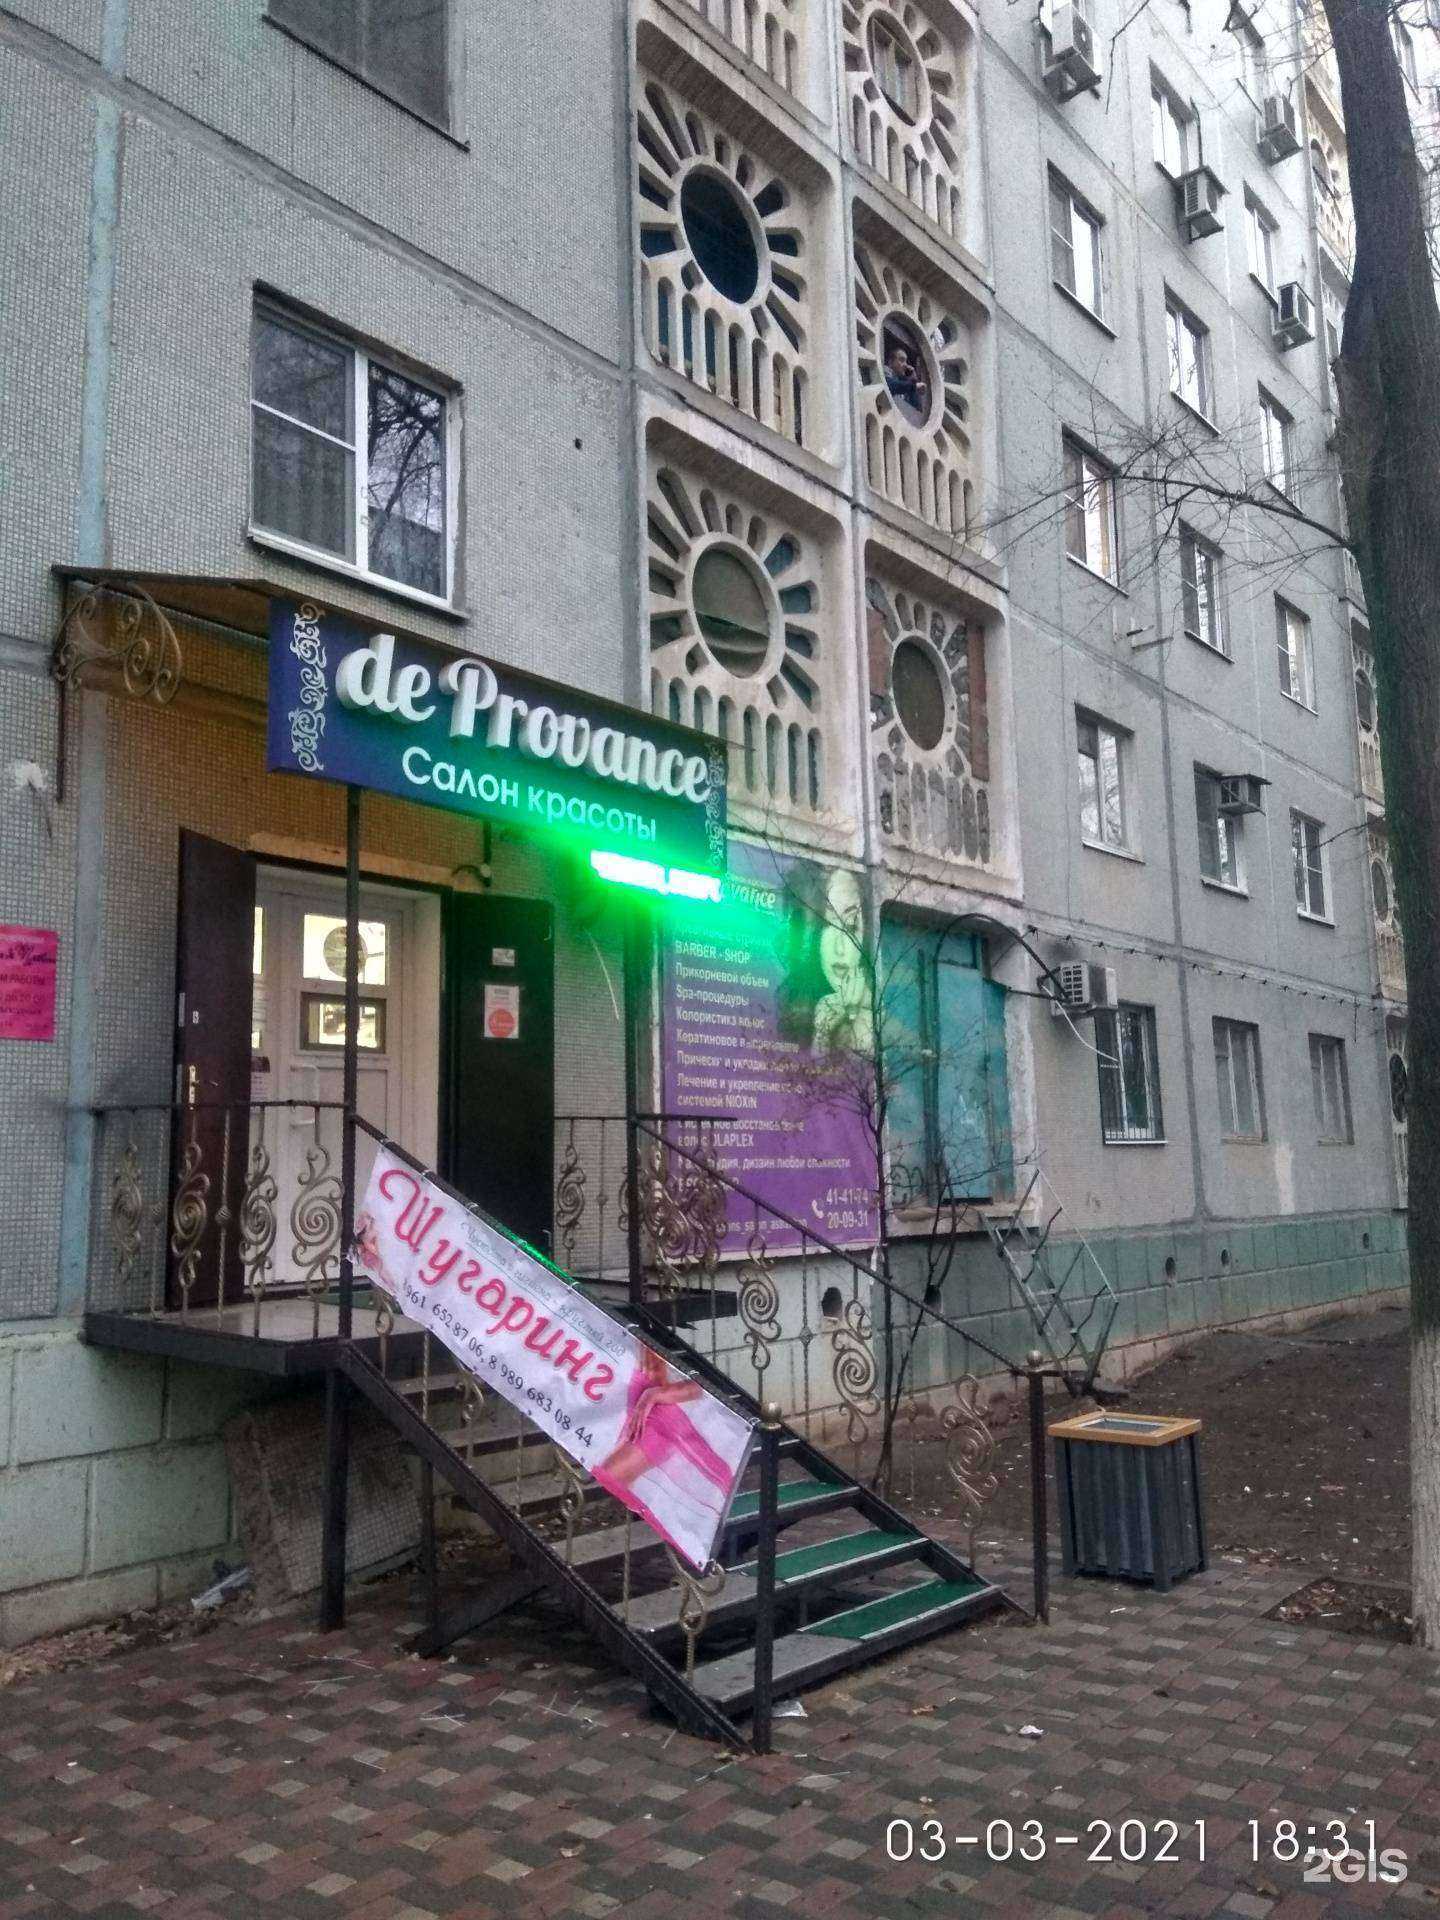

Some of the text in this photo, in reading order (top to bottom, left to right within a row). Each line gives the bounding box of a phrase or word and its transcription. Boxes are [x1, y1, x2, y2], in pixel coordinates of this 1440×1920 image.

[336, 633, 711, 804] de Provance
[402, 745, 657, 843] Салон красоты
[675, 940, 717, 959] BARBER
[724, 948, 751, 964] SHOP
[676, 984, 750, 1008] Spa-процедуры
[676, 1006, 737, 1026] Колористика
[676, 1028, 738, 1048] Кератиновое
[676, 1073, 719, 1089] Лечение
[379, 1168, 615, 1403] Шугаринг
[432, 1304, 453, 1328] 652
[453, 1322, 469, 1341] 87
[488, 1355, 498, 1370] 8
[500, 1364, 524, 1390] 989
[527, 1387, 553, 1413] 683
[554, 1408, 571, 1431] 08
[575, 1426, 593, 1448] 44
